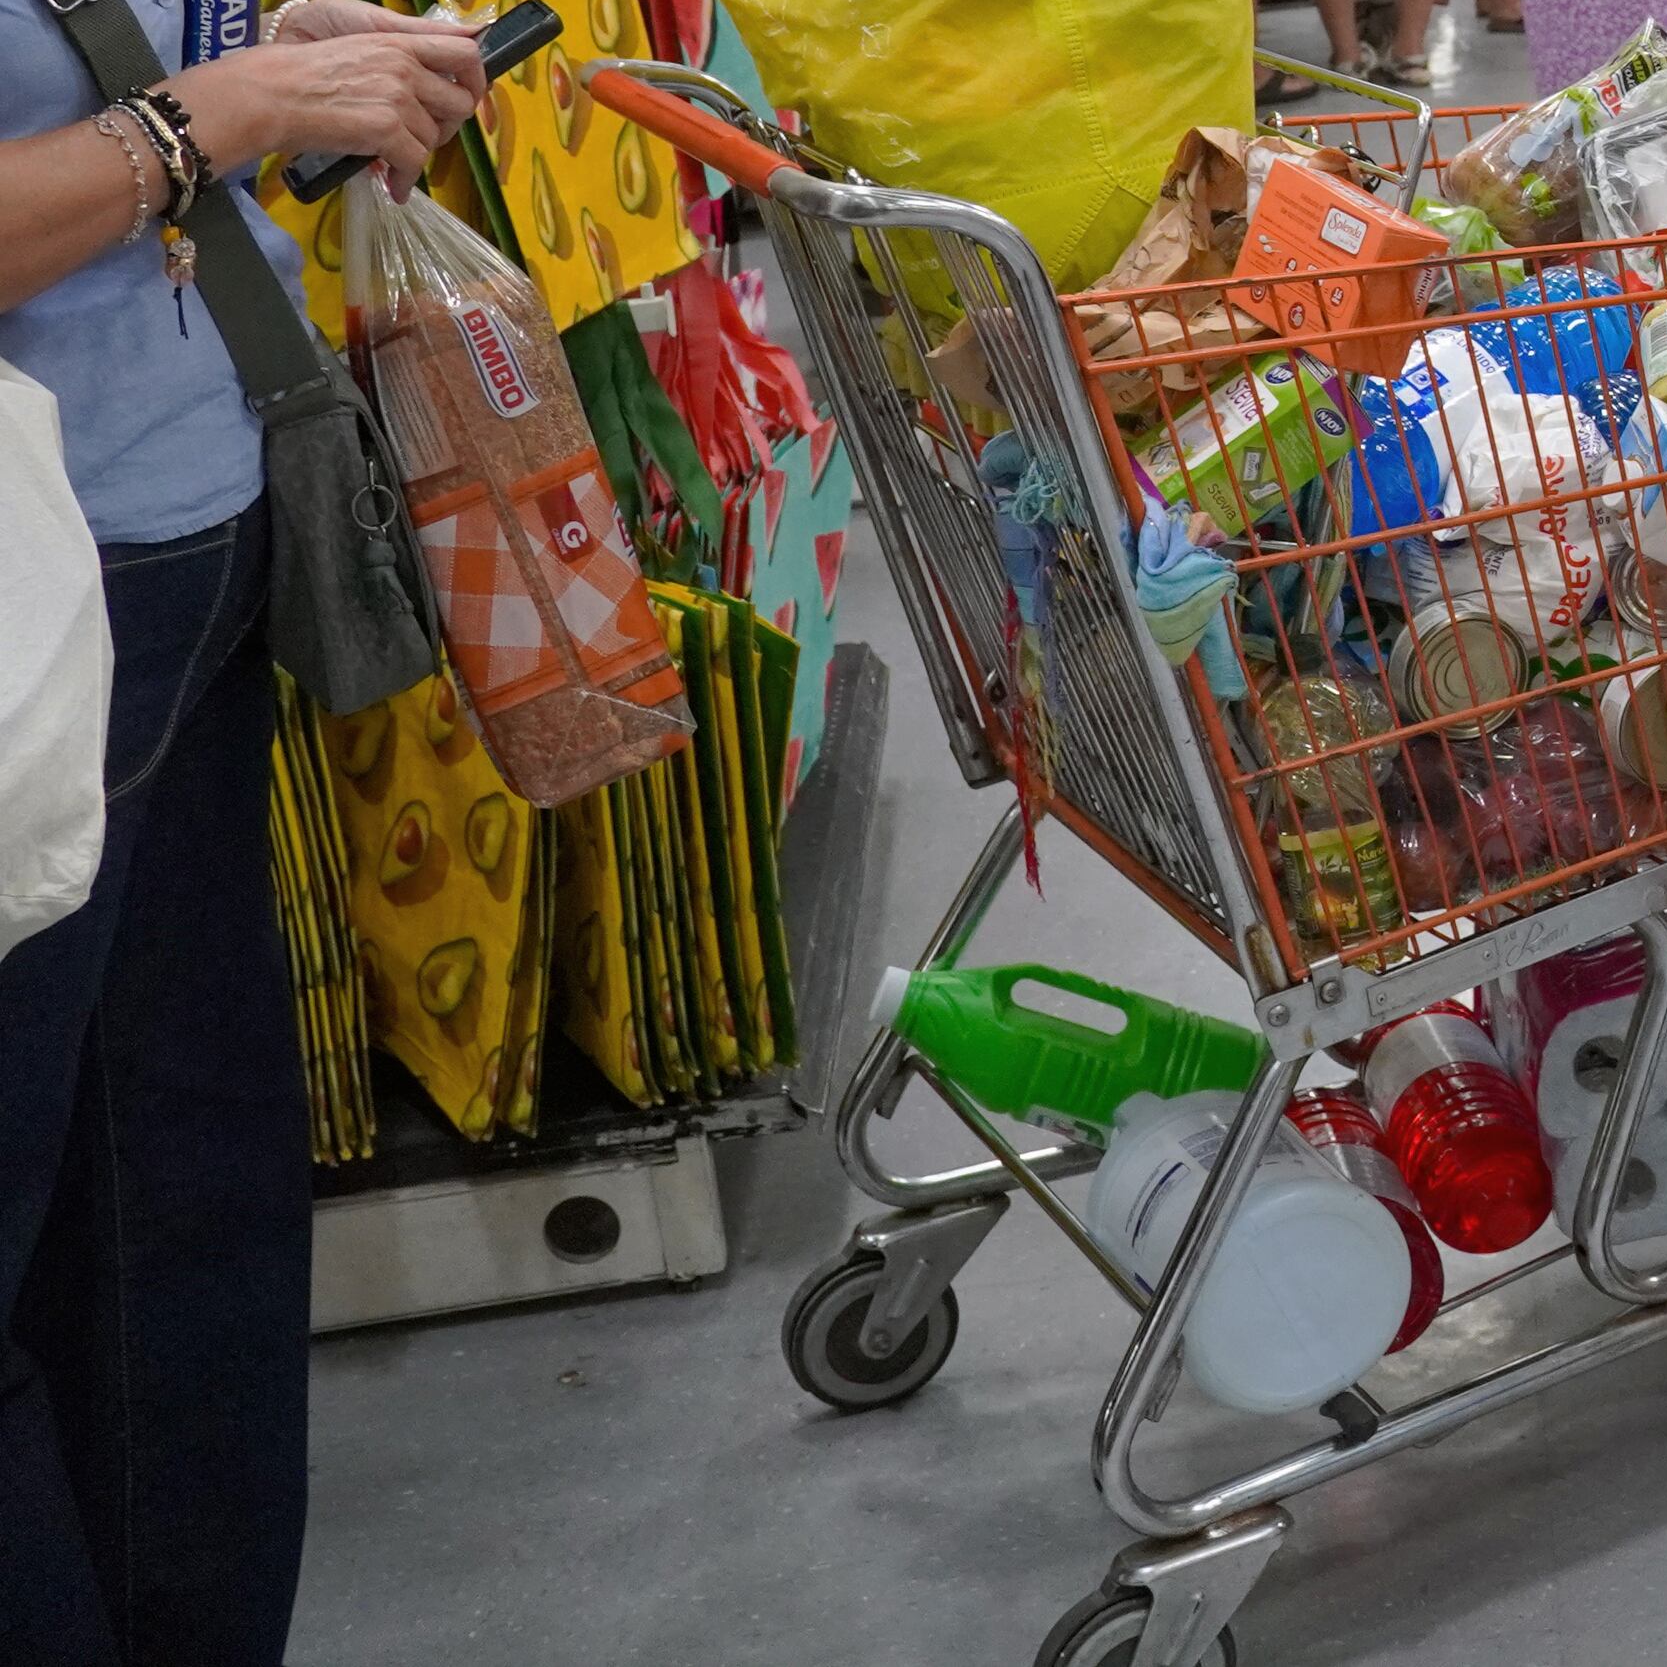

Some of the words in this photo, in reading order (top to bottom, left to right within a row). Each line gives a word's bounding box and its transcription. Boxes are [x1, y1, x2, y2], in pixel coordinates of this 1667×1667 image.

[1328, 212, 1361, 240] Splenda
[1416, 267, 1432, 306] plenda
[463, 309, 525, 410] BIMBO
[1225, 376, 1264, 423] Stevia
[1316, 409, 1344, 434] NJOY
[1207, 483, 1237, 523] Stevia
